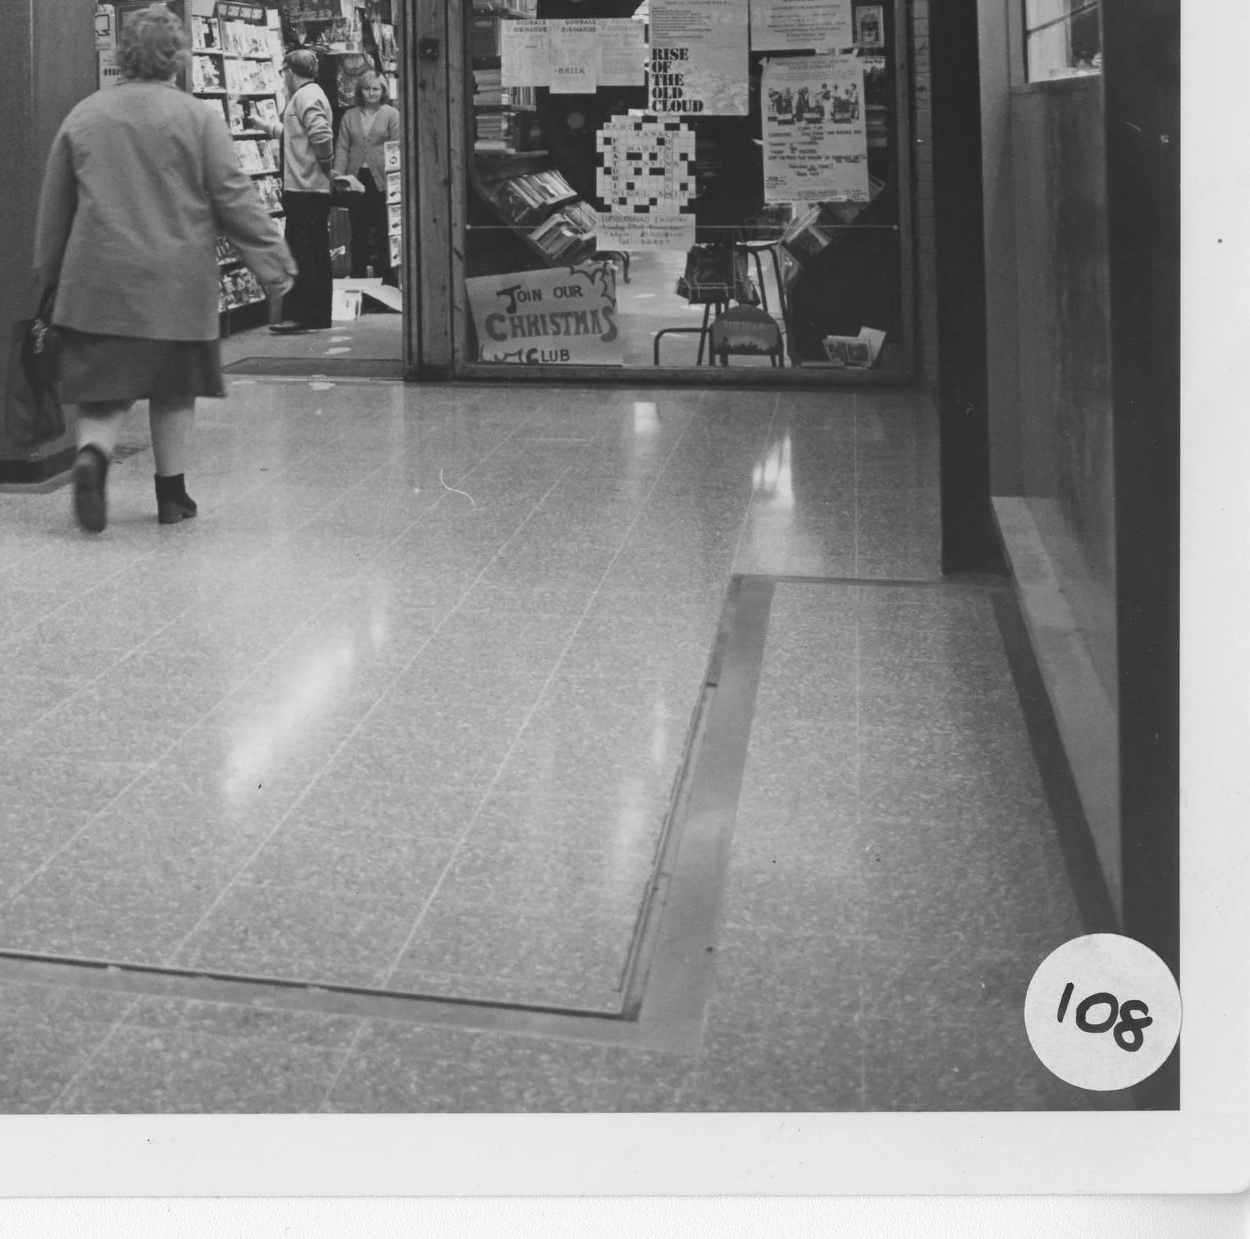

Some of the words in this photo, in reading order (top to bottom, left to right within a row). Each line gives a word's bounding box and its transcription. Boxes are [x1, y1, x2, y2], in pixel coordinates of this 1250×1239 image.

[652, 48, 689, 61] RISE
[651, 61, 672, 73] OF
[651, 73, 685, 86] THE
[652, 87, 684, 99] OLD
[652, 99, 704, 112] CLOUD
[497, 284, 543, 315] JOIN
[553, 284, 585, 299] OUR
[485, 305, 618, 343] CHRISTMAS
[525, 347, 571, 363] CLUB
